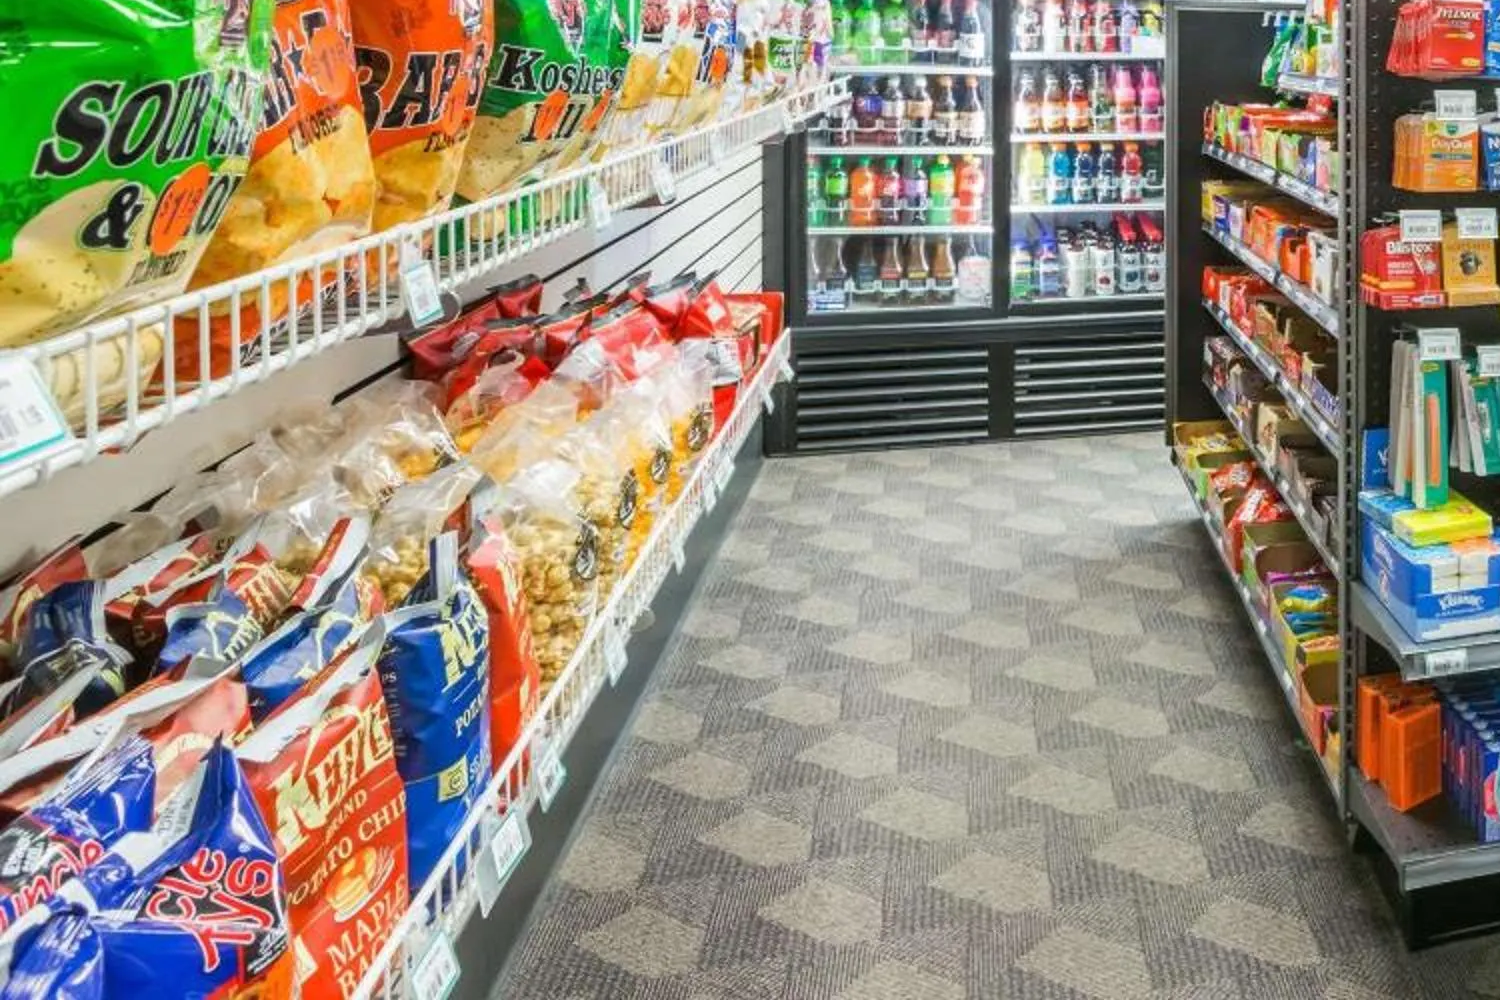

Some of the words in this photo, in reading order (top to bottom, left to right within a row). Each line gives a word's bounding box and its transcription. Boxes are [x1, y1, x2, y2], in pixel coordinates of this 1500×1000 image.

[31, 70, 214, 179] SOUR
[80, 182, 146, 249] &
[358, 791, 407, 842] CHIP
[326, 875, 407, 974] MAPLE
